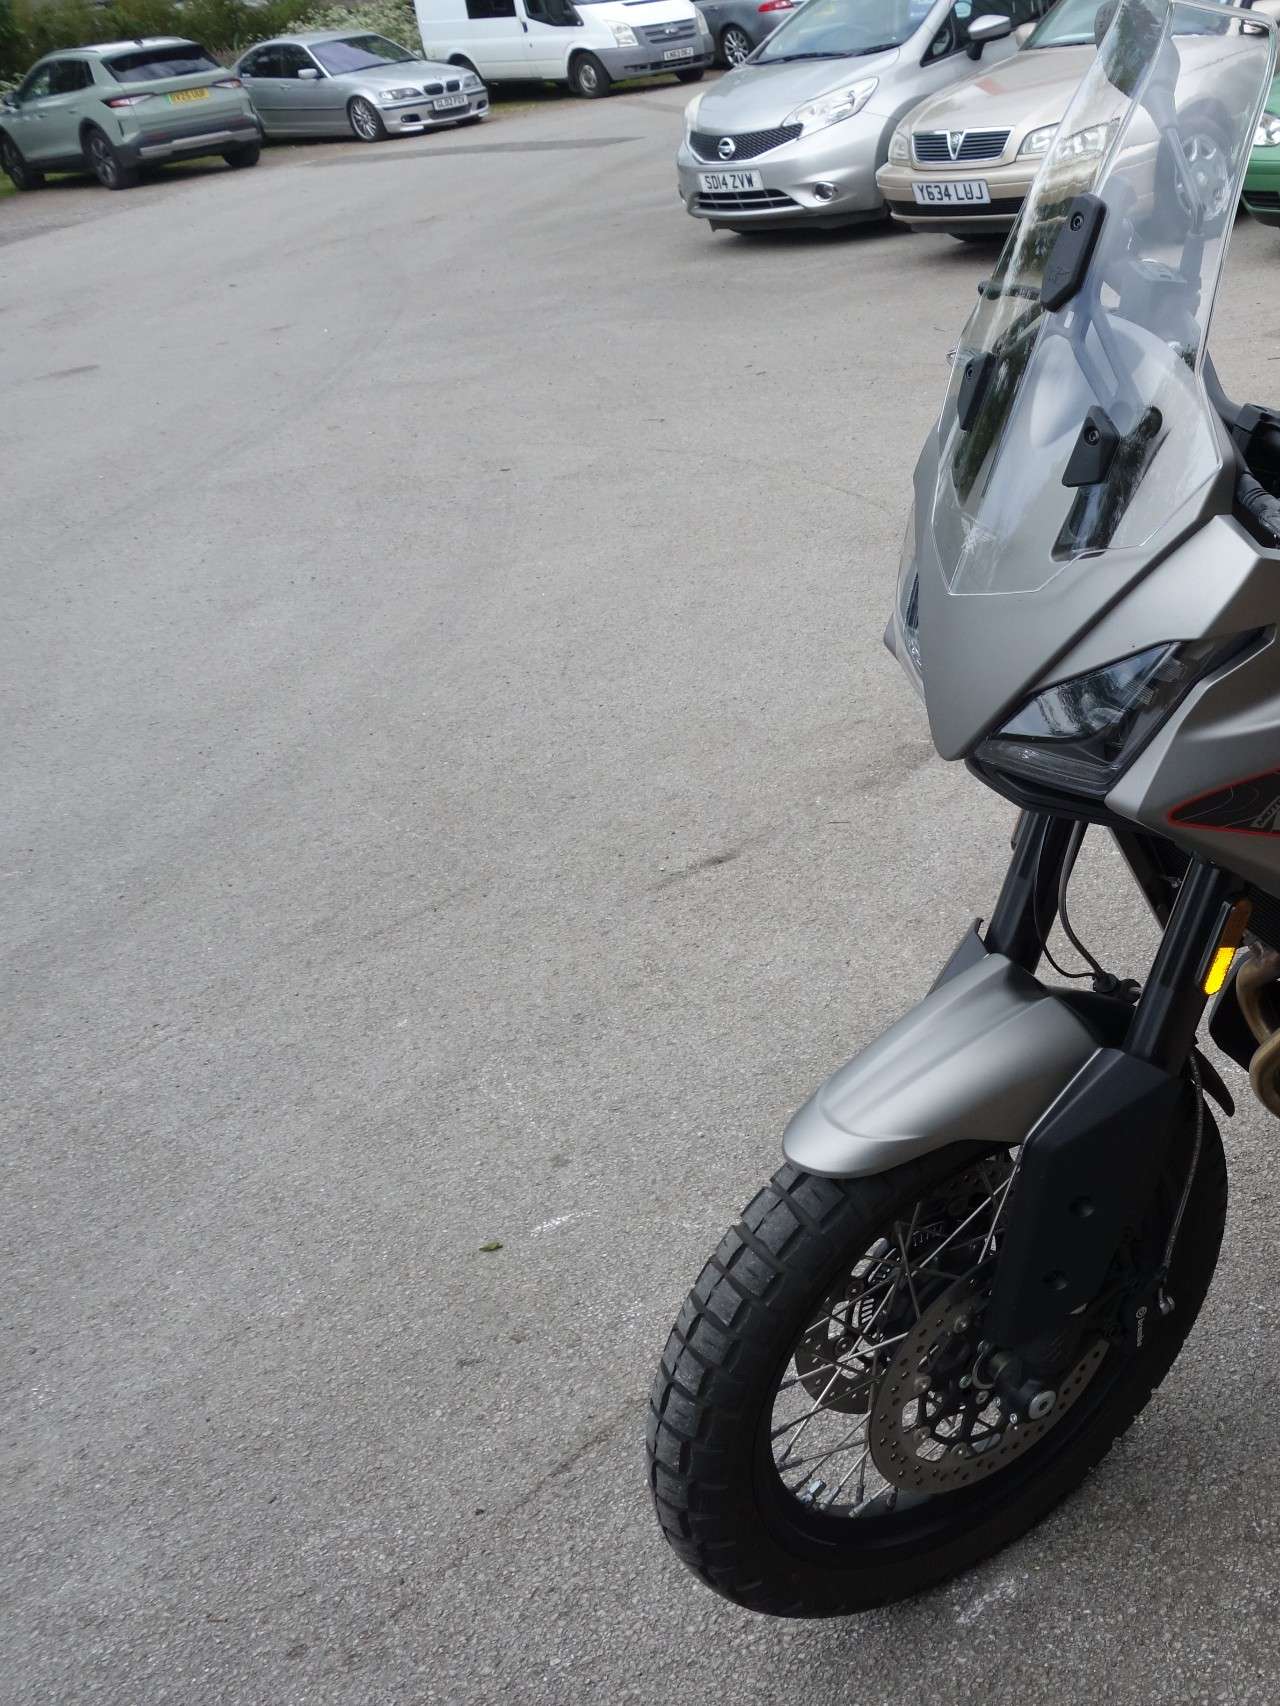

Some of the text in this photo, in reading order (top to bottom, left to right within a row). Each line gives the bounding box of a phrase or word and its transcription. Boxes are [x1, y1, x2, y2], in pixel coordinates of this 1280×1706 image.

[704, 173, 753, 189] SD14 ZVW
[917, 183, 983, 201] Y634 LUJ
